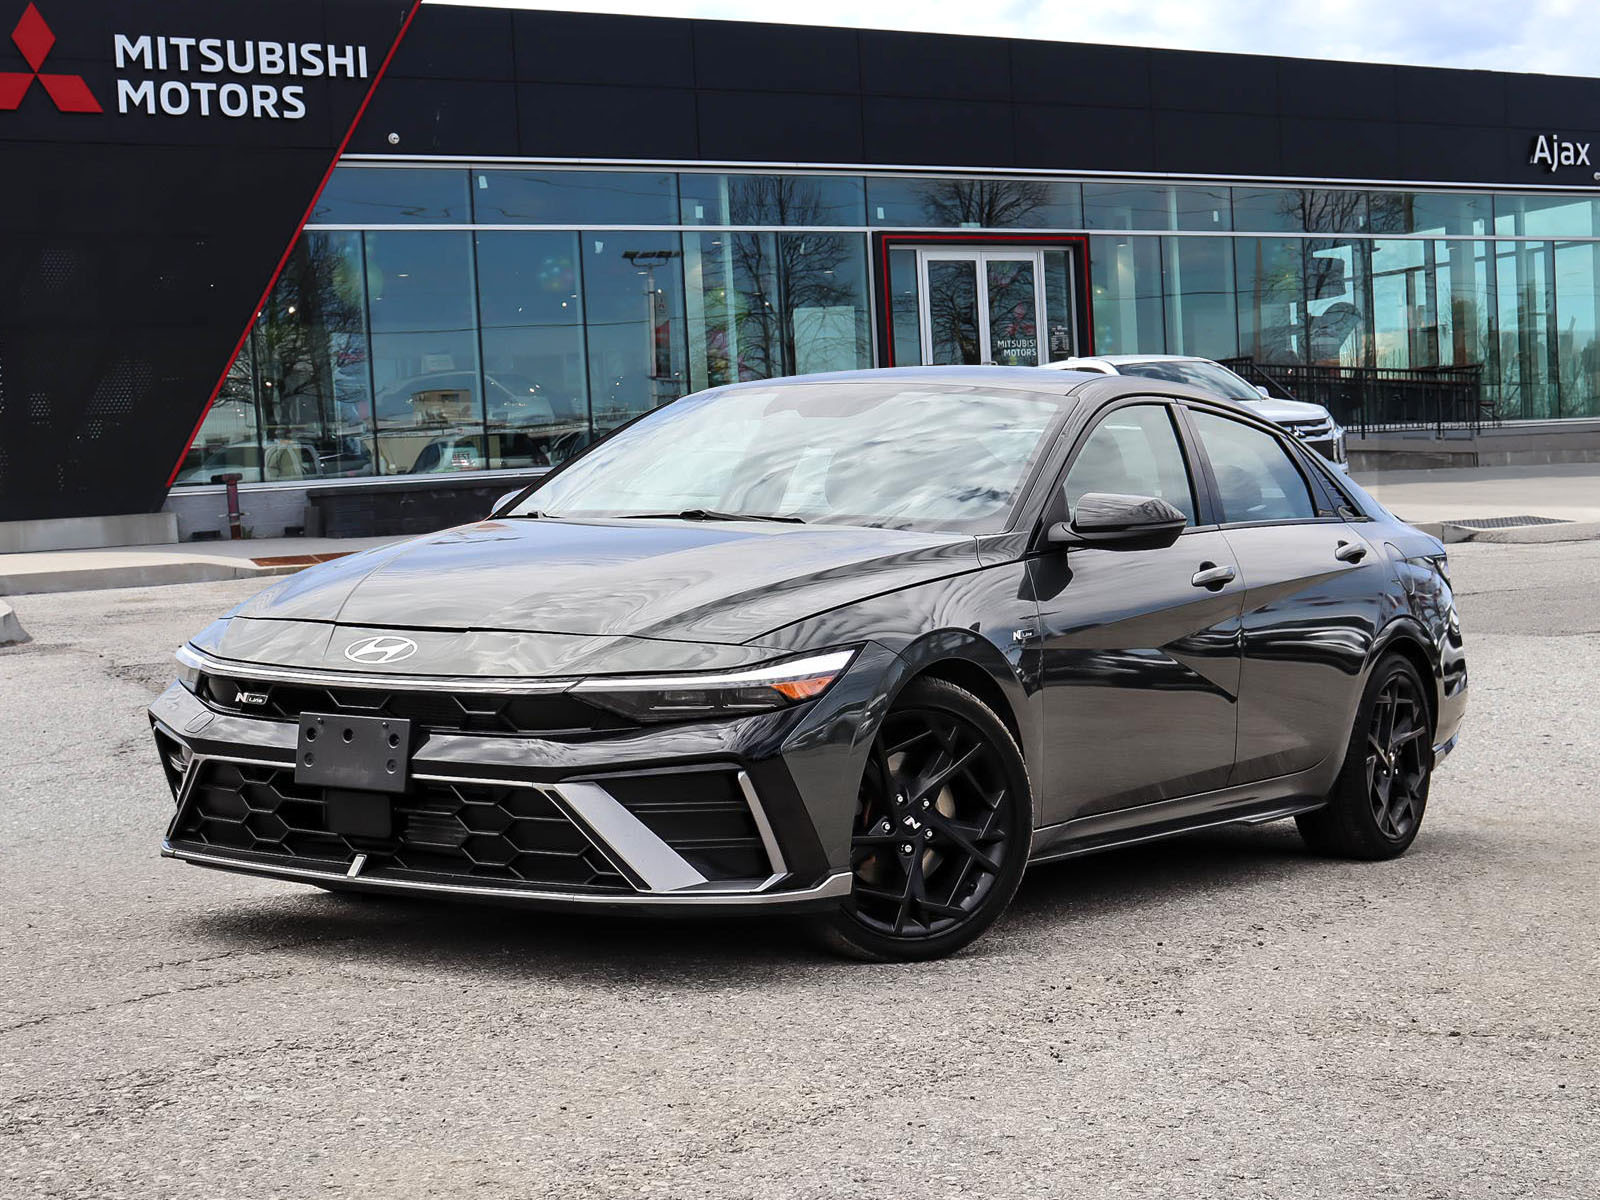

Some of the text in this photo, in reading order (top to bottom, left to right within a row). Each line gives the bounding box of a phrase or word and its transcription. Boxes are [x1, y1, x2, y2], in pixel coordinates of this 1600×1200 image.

[114, 34, 368, 78] MITSUBISHI
[117, 79, 306, 119] MOTORS
[1533, 134, 1591, 172] Ajax
[1003, 348, 1037, 357] MOTORS
